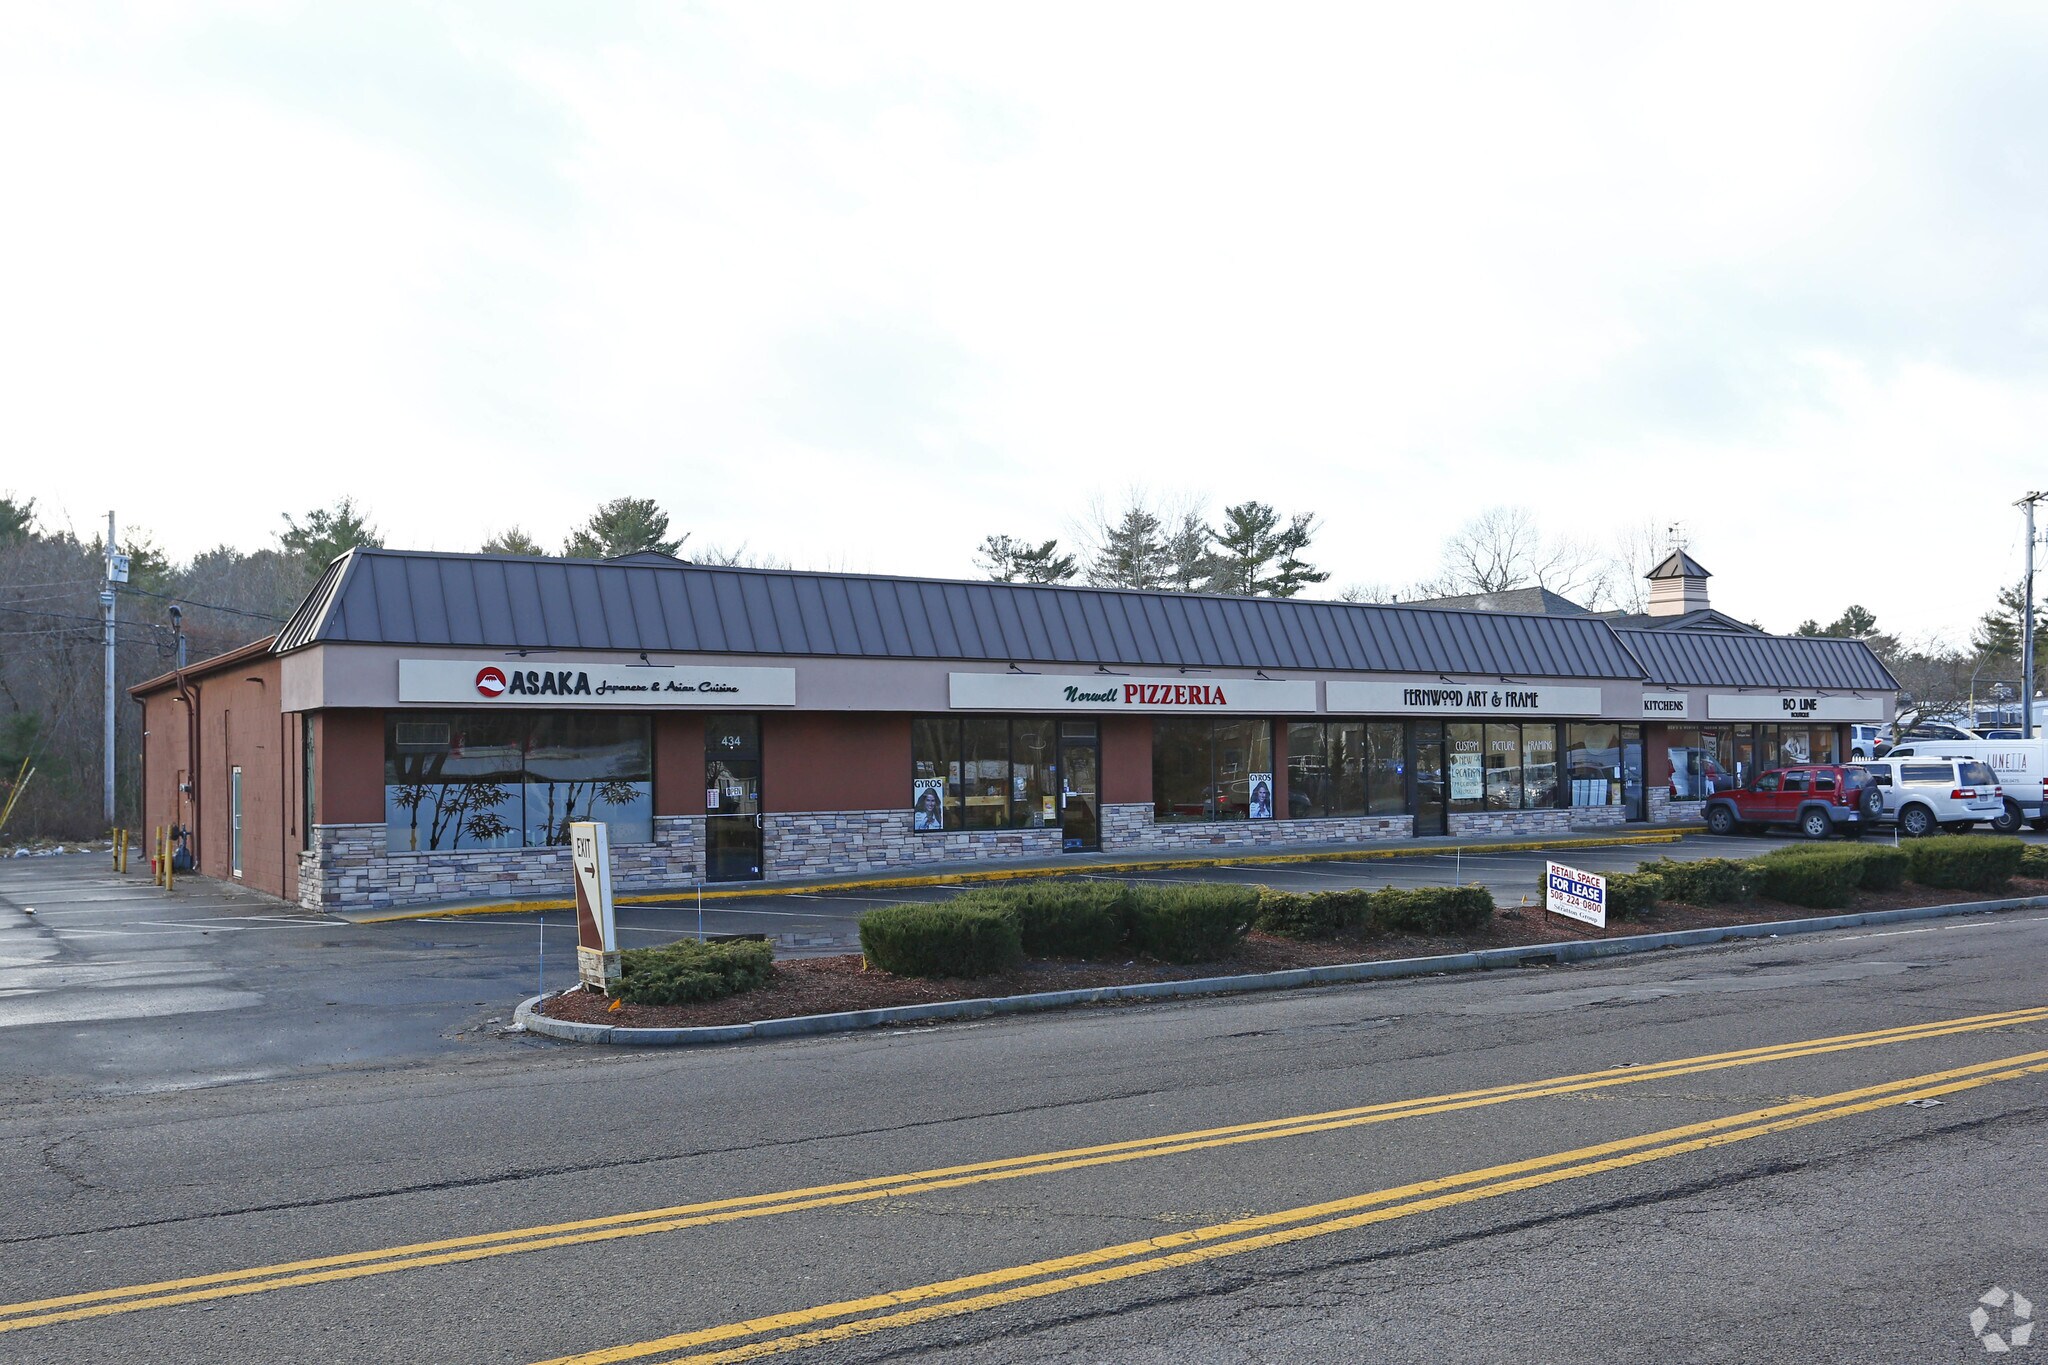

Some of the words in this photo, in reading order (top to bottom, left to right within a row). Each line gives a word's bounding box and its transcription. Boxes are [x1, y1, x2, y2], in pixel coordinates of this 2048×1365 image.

[509, 670, 591, 696] ASAKA
[596, 681, 649, 695] Japanese
[651, 681, 660, 692] &
[664, 680, 696, 692] Asian
[698, 682, 739, 693] Cuisine
[1064, 685, 1118, 703] Norwell
[1123, 683, 1227, 705] PIZZERIA
[1403, 688, 1463, 707] FERNWOOD
[1466, 690, 1488, 707] ART
[1491, 690, 1503, 708] &
[1505, 691, 1539, 709] FRAME
[1643, 699, 1684, 712] KITCHENS
[1783, 698, 1796, 711] BO
[1799, 699, 1817, 711] LINE
[721, 735, 742, 746] 434
[1455, 740, 1480, 751] CUSTOM
[1491, 740, 1516, 751] PICTURE
[1527, 740, 1553, 751] FRAMING
[1459, 756, 1473, 766] NEW
[1250, 773, 1272, 781] GYROS
[1452, 767, 1481, 779] LOCATION
[914, 779, 942, 789] GYROS
[576, 837, 591, 859] EXIT
[1551, 865, 1575, 881] RETAIL
[1577, 872, 1601, 888] SPACE
[1552, 876, 1569, 894] FOR
[1571, 882, 1600, 901] LEASE
[1579, 911, 1599, 924] Group
